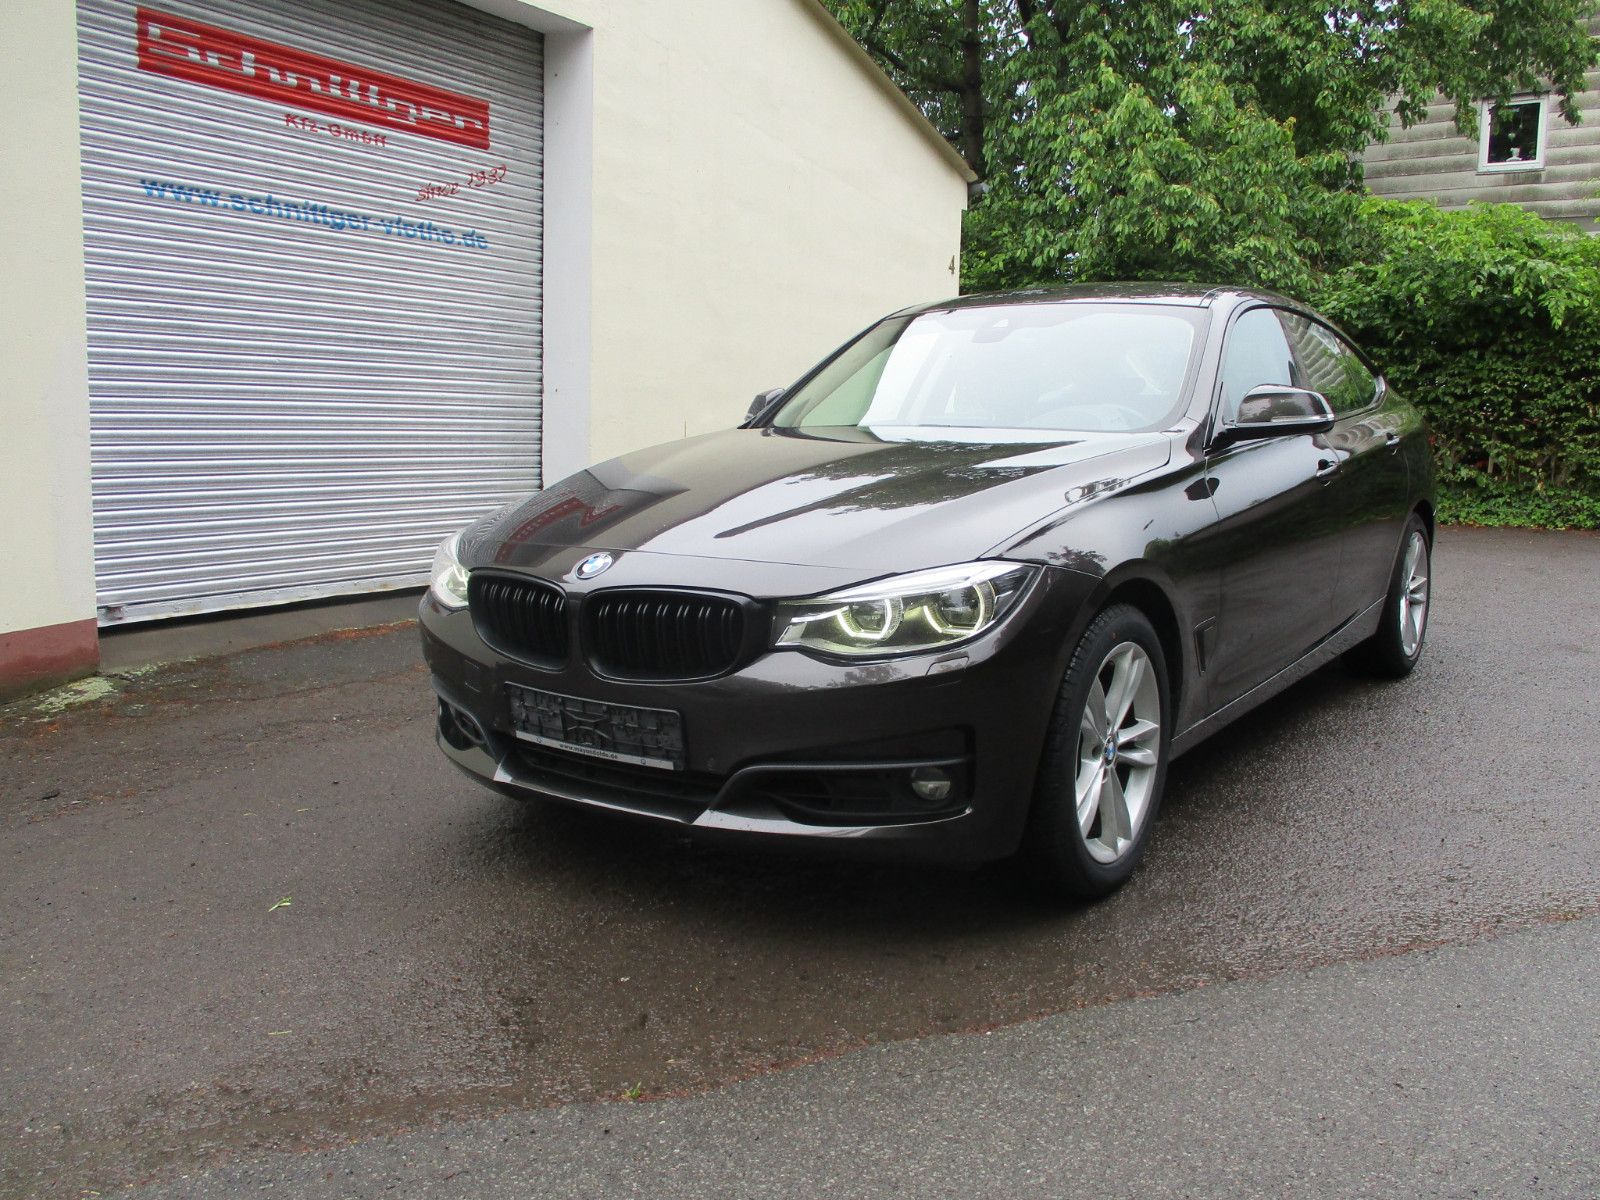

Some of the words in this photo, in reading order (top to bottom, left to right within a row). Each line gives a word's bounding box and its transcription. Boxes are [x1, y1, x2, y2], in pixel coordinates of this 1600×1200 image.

[147, 22, 485, 129] Schnittger
[284, 113, 387, 148] Kfz-GmbH
[415, 182, 460, 202] since
[140, 178, 488, 249] www.schnittger-vlotho.de
[948, 254, 956, 275] 4
